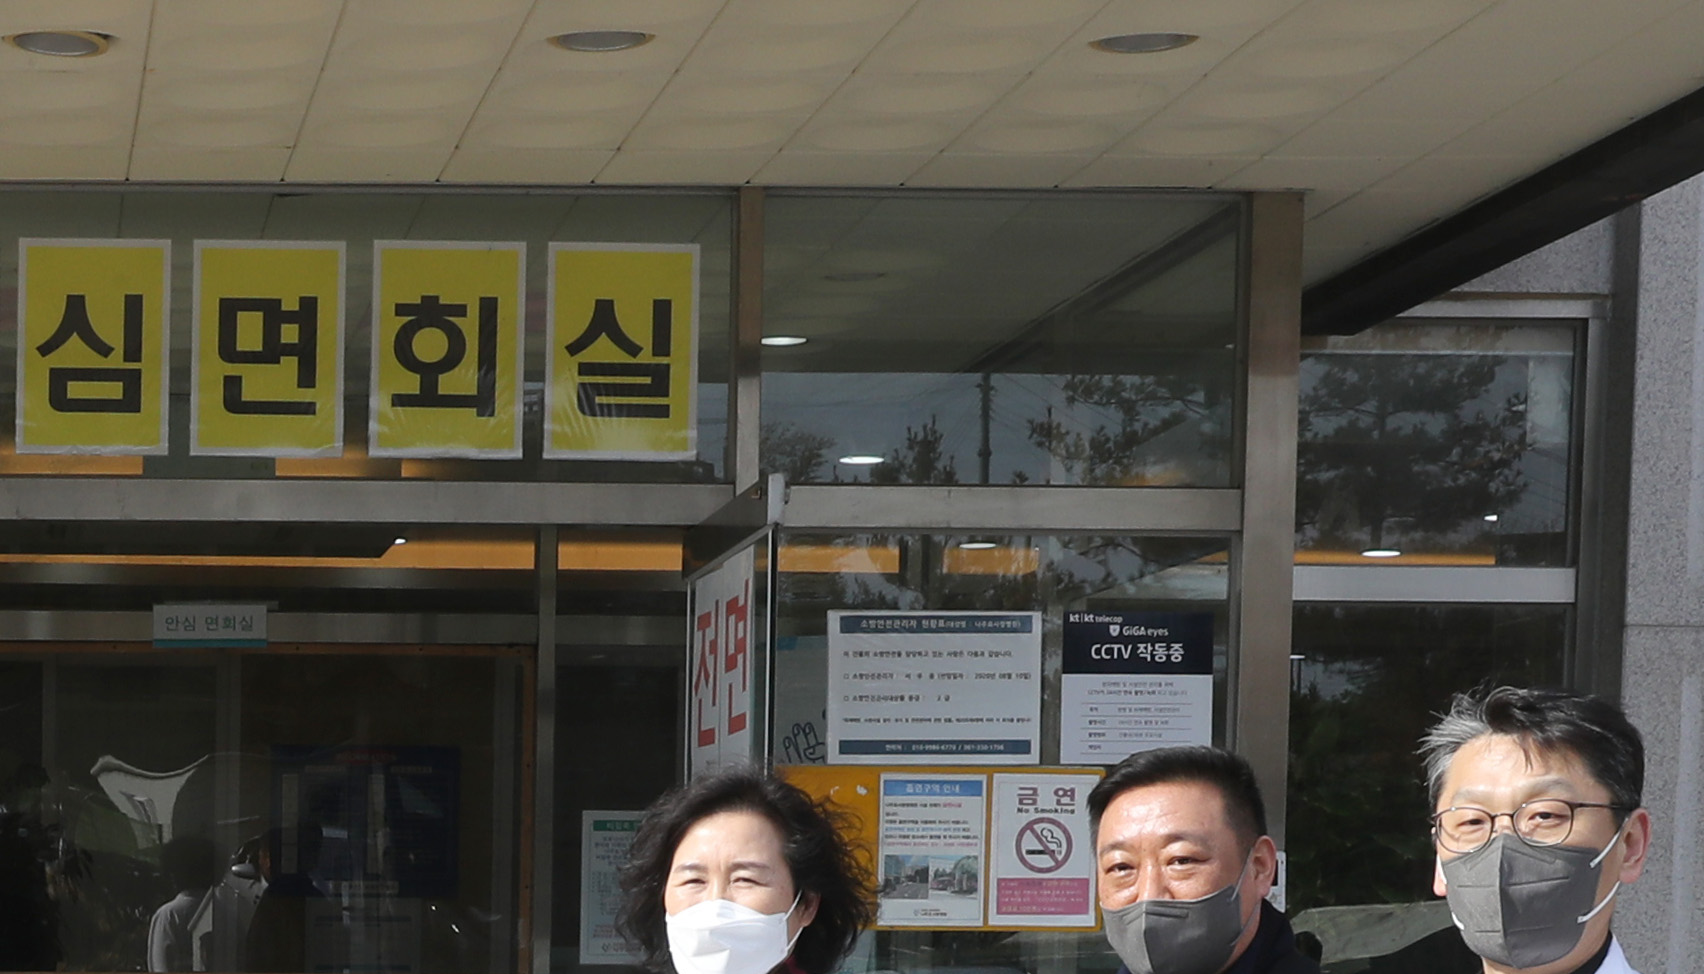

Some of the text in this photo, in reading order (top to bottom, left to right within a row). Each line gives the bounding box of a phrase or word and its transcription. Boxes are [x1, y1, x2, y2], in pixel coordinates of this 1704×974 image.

[164, 615, 254, 632] 안심 면회실
[1069, 613, 1080, 623] kt
[1084, 613, 1095, 623] kt
[1122, 626, 1169, 638] GiGA eyes
[1091, 642, 1185, 662] CCTV 작동중
[694, 578, 749, 748] 전면
[943, 783, 961, 793] 안내
[1016, 786, 1076, 807] 금연
[1016, 807, 1076, 815] No Smoking
